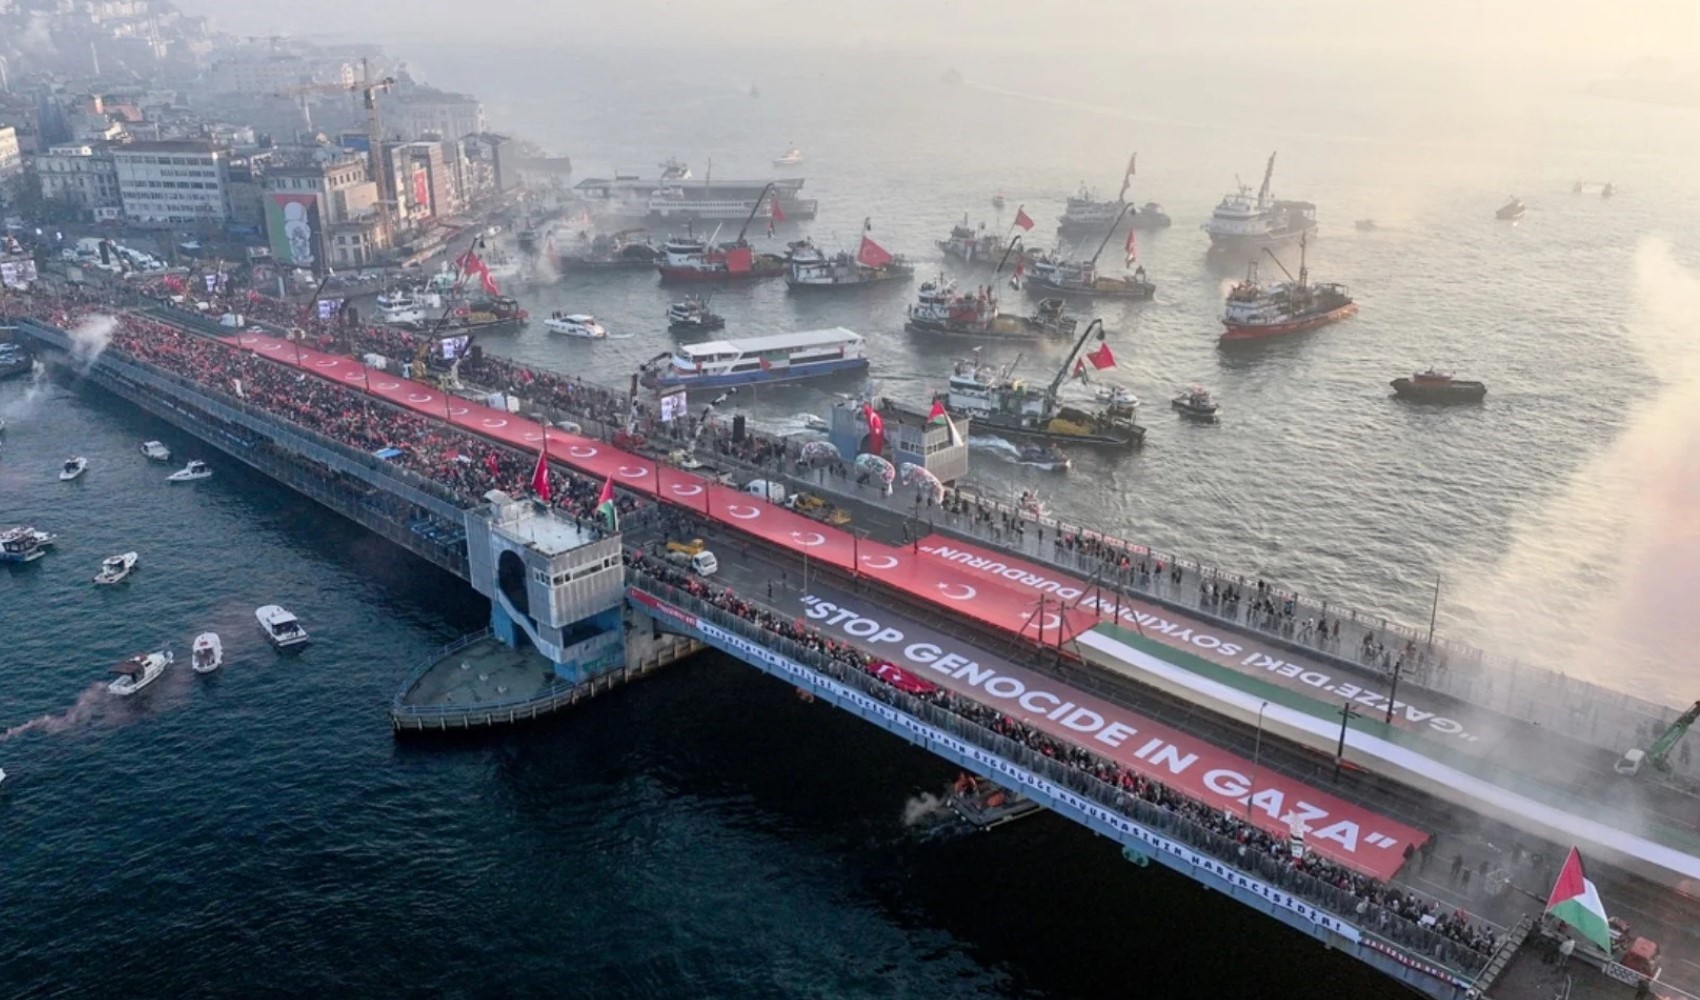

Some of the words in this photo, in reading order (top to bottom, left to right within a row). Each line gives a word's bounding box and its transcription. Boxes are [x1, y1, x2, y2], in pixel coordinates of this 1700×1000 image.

[919, 546, 1083, 600] DURDURUN"
[1081, 595, 1243, 656] SOYKIRIMI
[800, 595, 904, 643] "STOP
[904, 643, 1137, 747] GENOCIDE
[1133, 738, 1199, 774] IN
[1203, 769, 1398, 853] GAZA"
